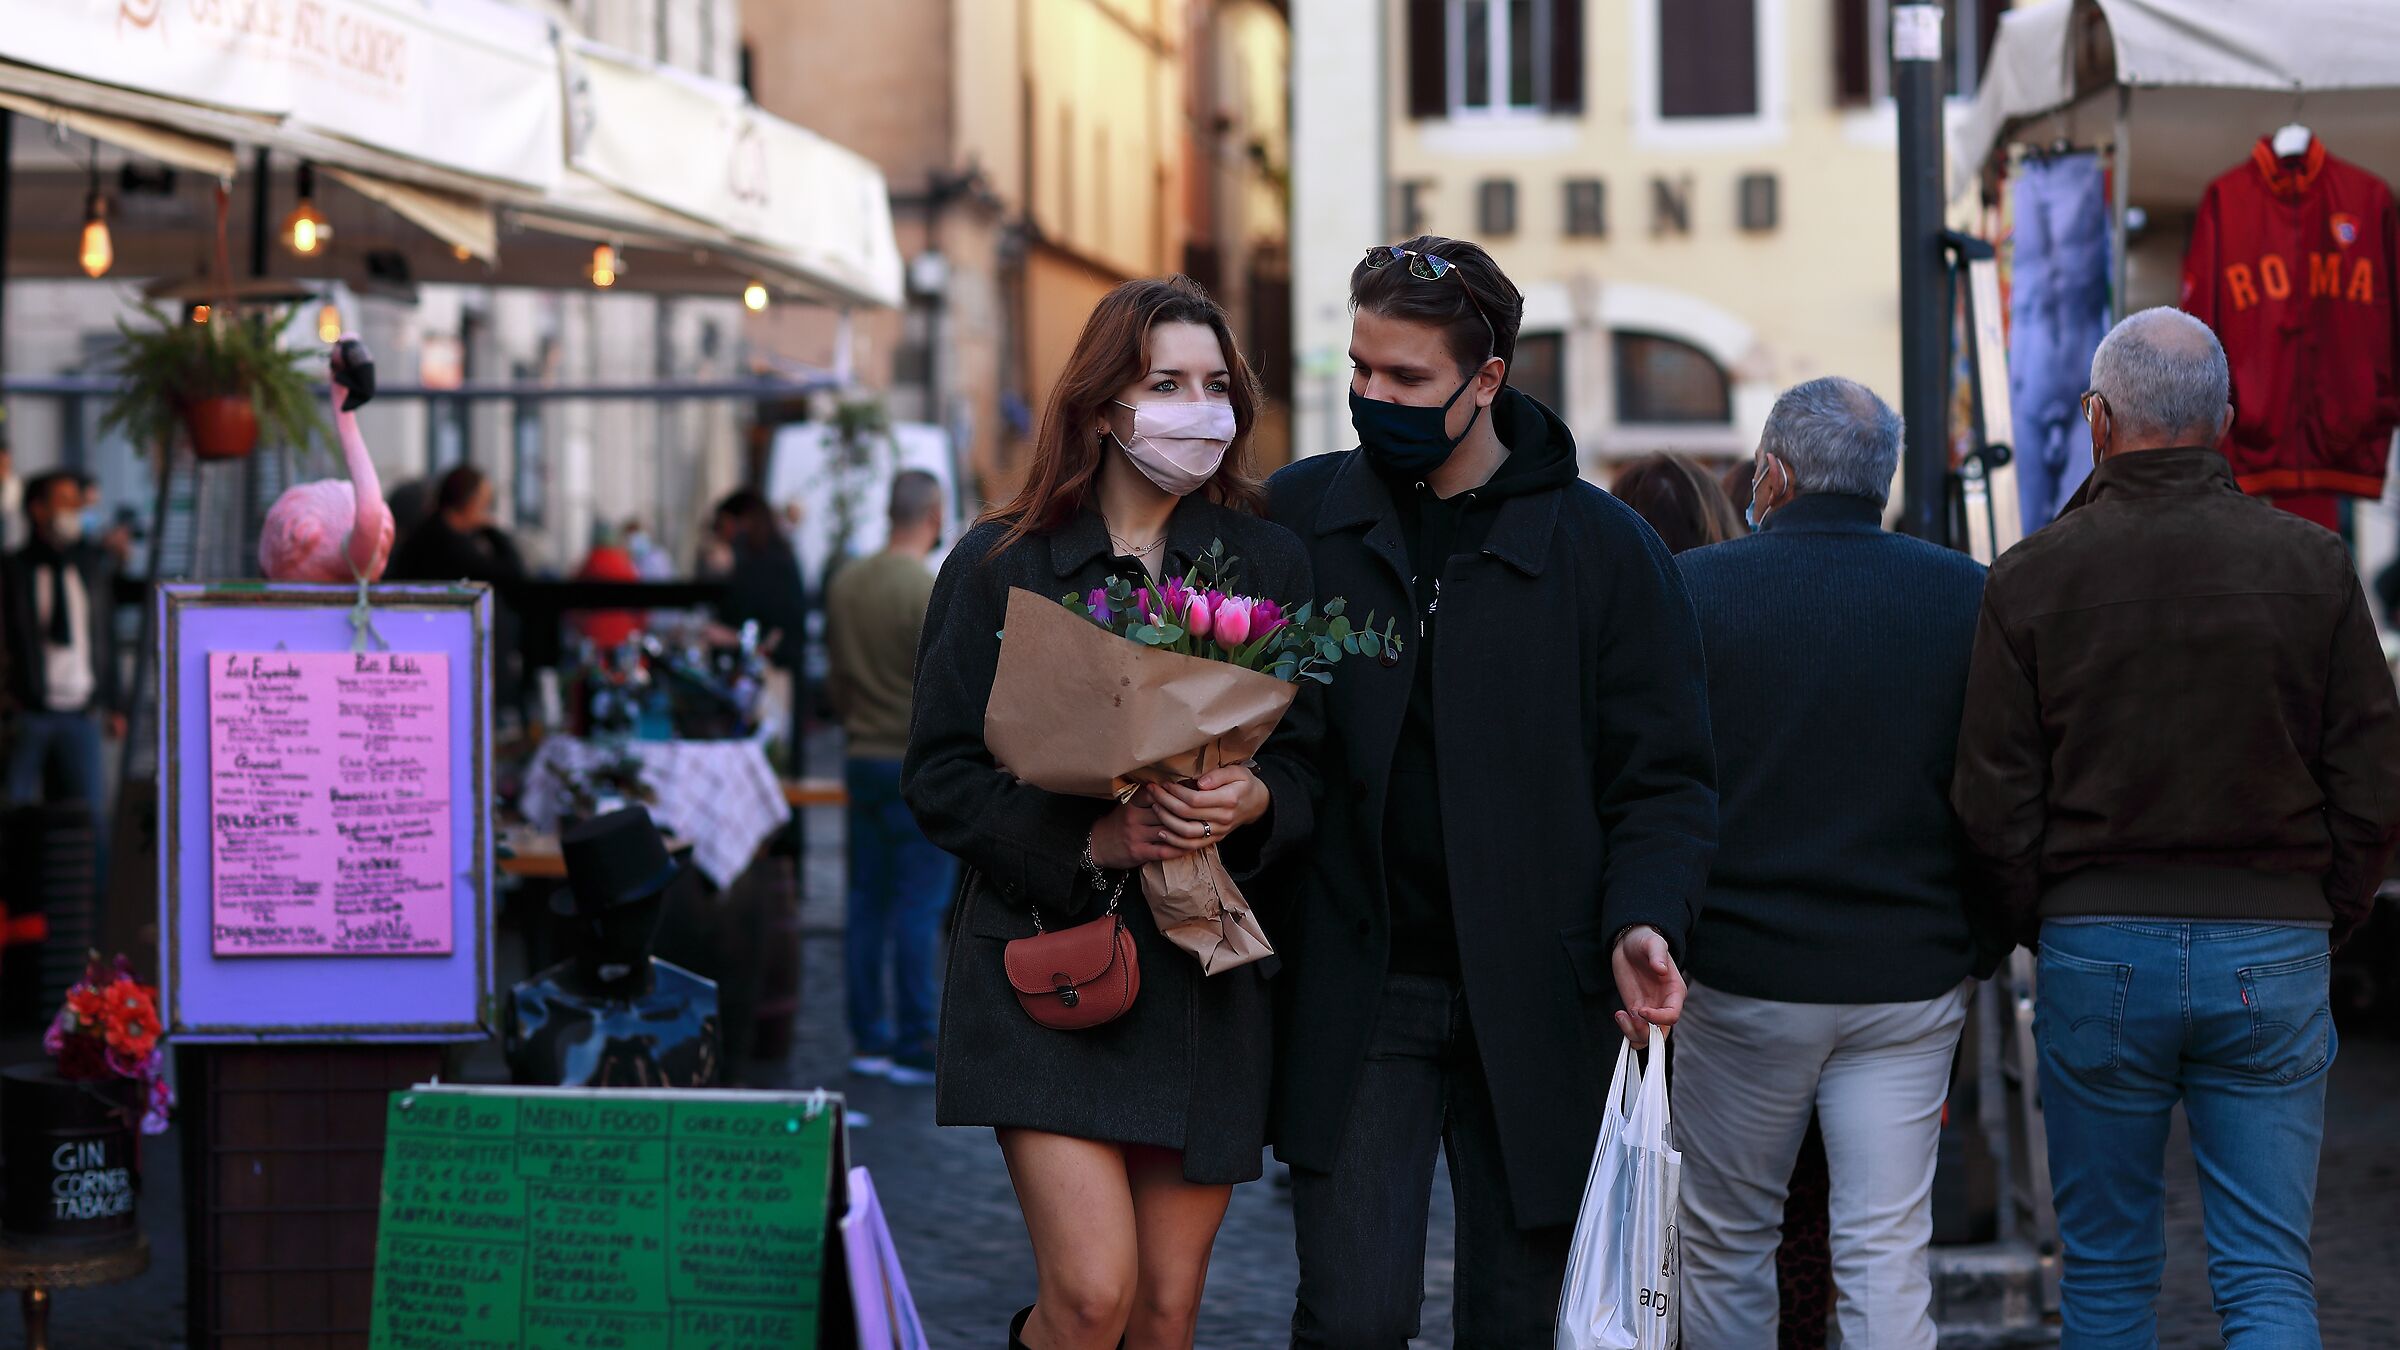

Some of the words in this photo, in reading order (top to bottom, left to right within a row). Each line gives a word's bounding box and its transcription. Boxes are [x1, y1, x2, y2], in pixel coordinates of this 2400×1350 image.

[1396, 170, 1780, 237] FORNO
[2225, 251, 2375, 312] ROMA
[599, 1107, 661, 1133] FOOD
[51, 1140, 106, 1171] GIN
[51, 1167, 130, 1198] CORNER
